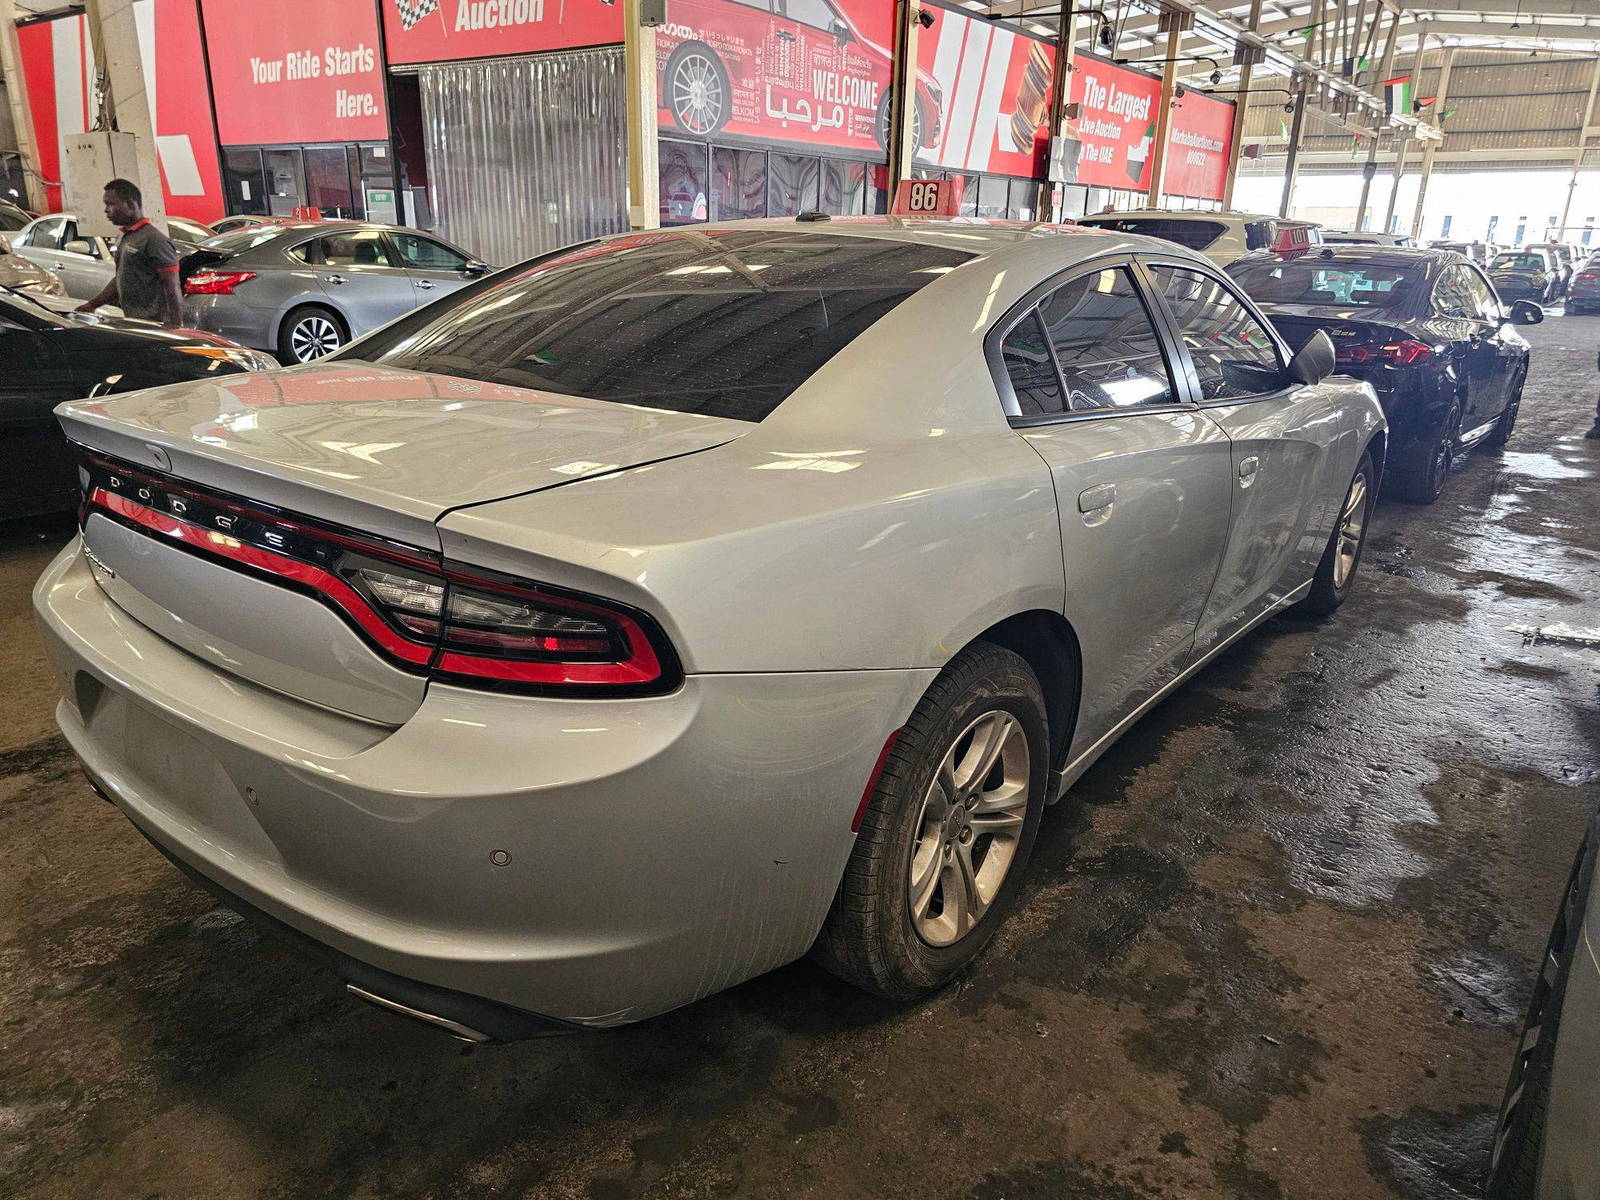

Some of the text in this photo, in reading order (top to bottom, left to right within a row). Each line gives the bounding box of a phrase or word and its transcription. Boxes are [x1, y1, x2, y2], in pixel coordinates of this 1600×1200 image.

[455, 0, 543, 32] Auction
[251, 44, 375, 85] Your Ride Starts
[336, 89, 378, 118] Here.
[813, 69, 879, 110] WELCOME
[1084, 76, 1151, 122] The Largest
[766, 84, 844, 132] مرحبا
[1079, 116, 1121, 139] Live Auction
[1086, 143, 1099, 161] The
[1099, 146, 1114, 164] UAE
[911, 183, 937, 210] 86
[1292, 230, 1306, 244] 101
[110, 475, 284, 547] DODGE
